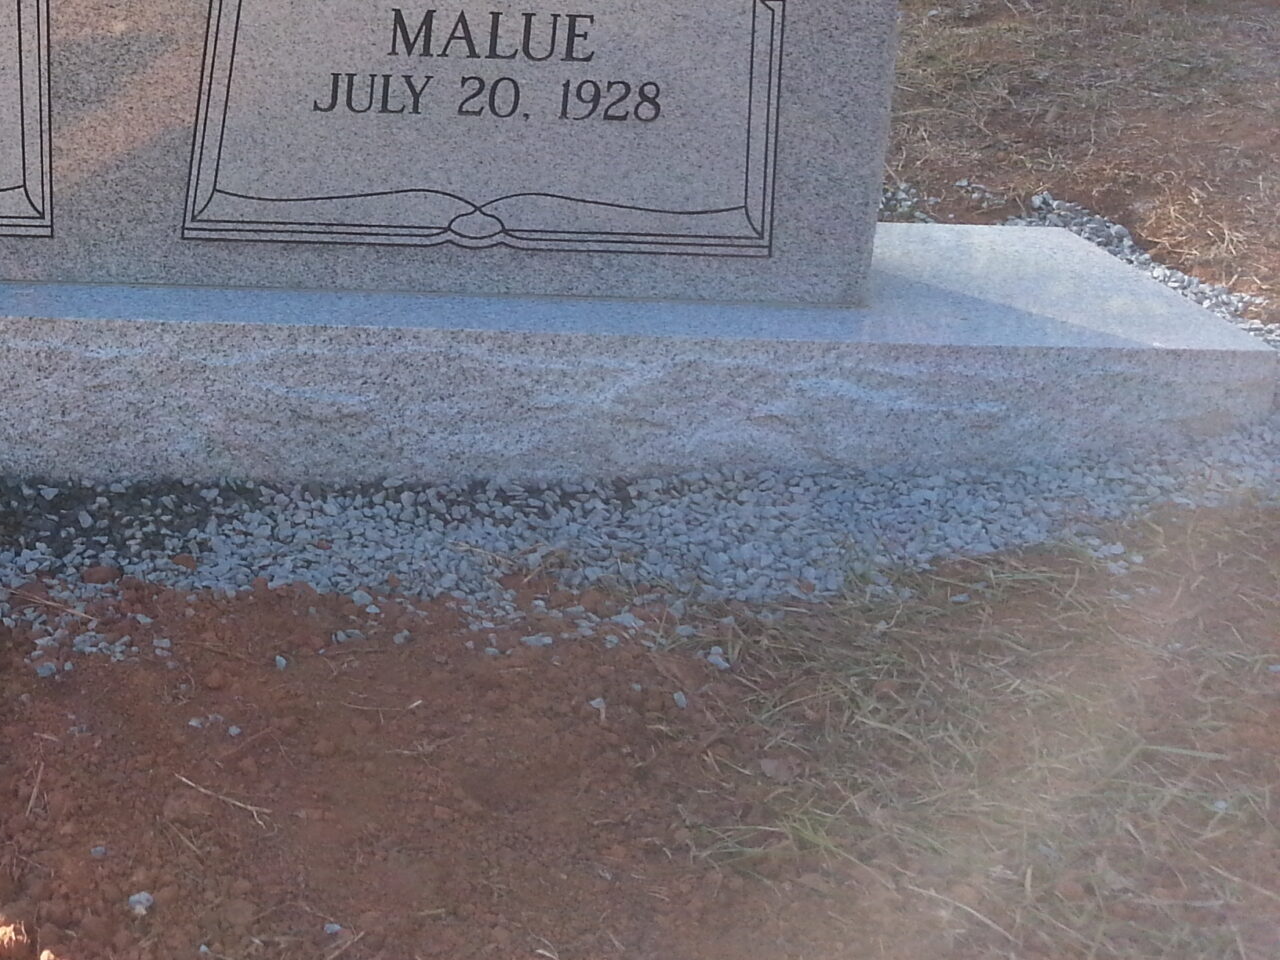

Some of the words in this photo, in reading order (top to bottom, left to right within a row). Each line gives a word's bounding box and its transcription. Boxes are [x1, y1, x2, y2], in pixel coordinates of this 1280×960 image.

[387, 8, 595, 62] MALUE
[313, 73, 434, 115] JULY
[457, 76, 530, 122] 20,
[558, 79, 662, 122] 1928
